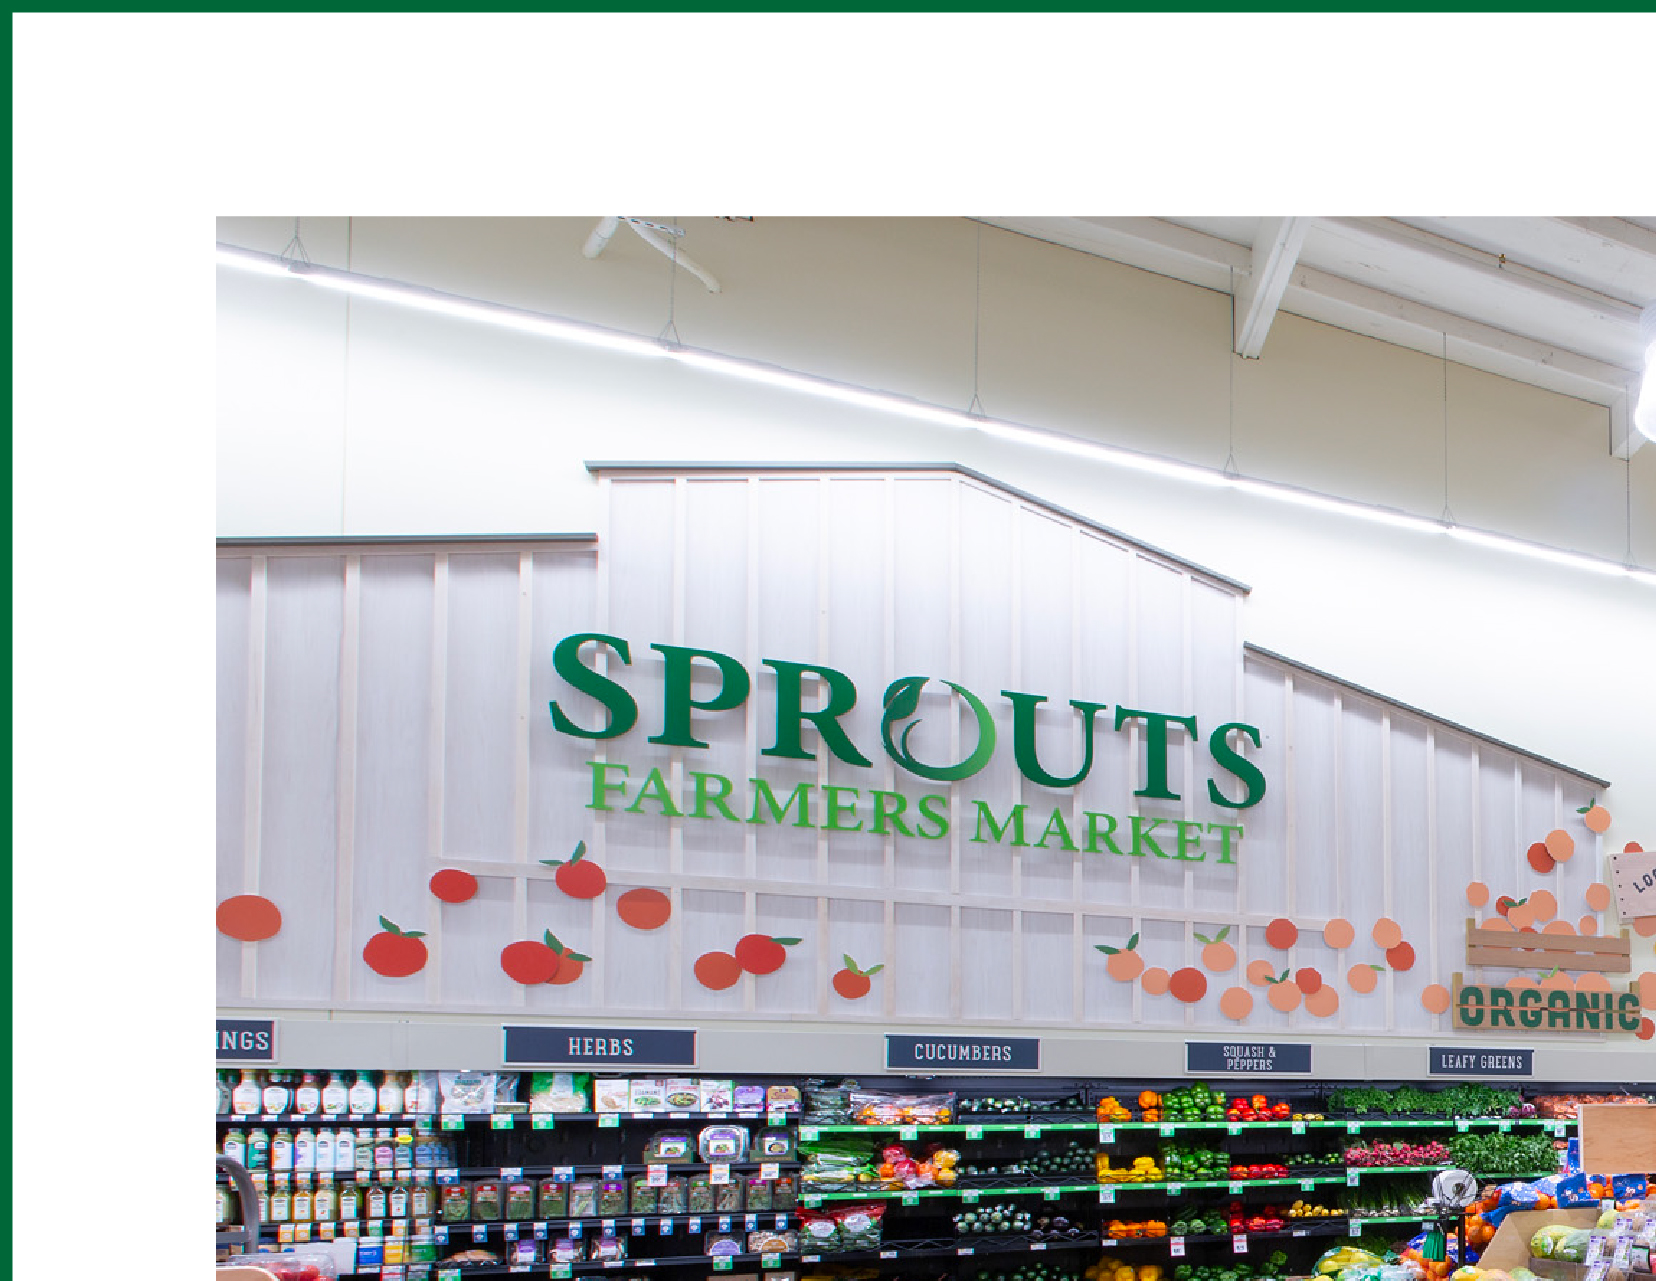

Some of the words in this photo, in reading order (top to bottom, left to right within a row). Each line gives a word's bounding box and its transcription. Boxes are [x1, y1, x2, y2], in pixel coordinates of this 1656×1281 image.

[548, 632, 1267, 810] SPROUTS
[585, 761, 950, 840] FARMERS
[969, 800, 1244, 864] MARKET
[1459, 986, 1641, 1030] ORGANIC
[568, 1036, 634, 1057] HERBS
[914, 1042, 1013, 1062] CUCUMBERS
[1223, 1045, 1264, 1059] SQUASH
[1226, 1058, 1274, 1071] PEPPERS
[1441, 1053, 1476, 1070] LEAFY
[1480, 1054, 1523, 1070] GREENS
